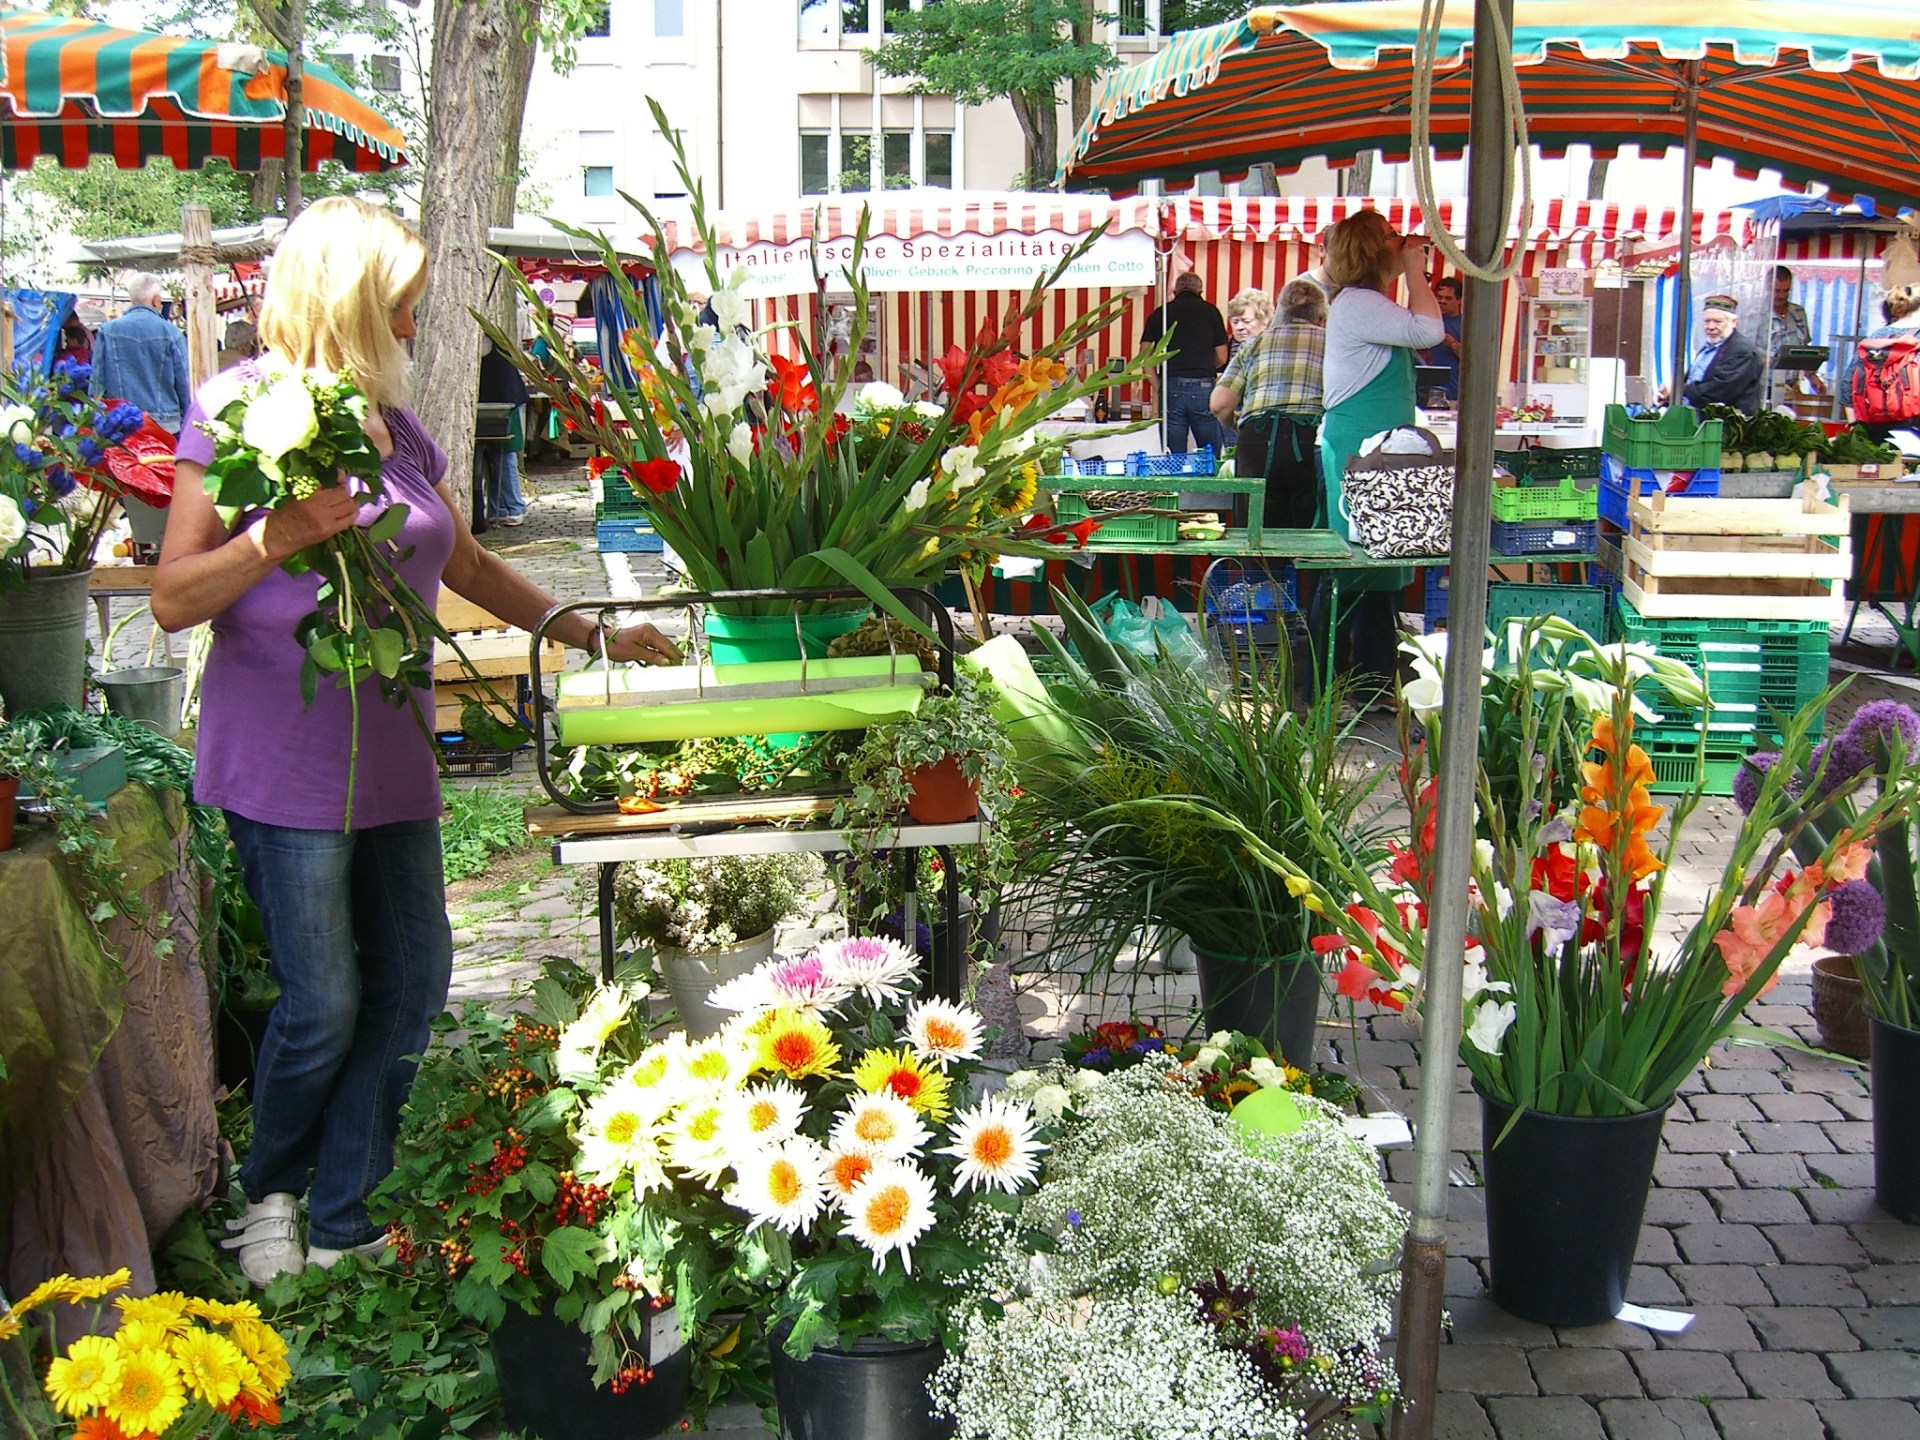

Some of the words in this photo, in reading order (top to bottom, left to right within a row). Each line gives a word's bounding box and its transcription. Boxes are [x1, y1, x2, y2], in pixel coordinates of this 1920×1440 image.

[903, 240, 1090, 262] Spezialitäte
[1040, 262, 1101, 274] Scnken
[1107, 260, 1144, 272] Cotto
[1540, 270, 1578, 279] Pecorino
